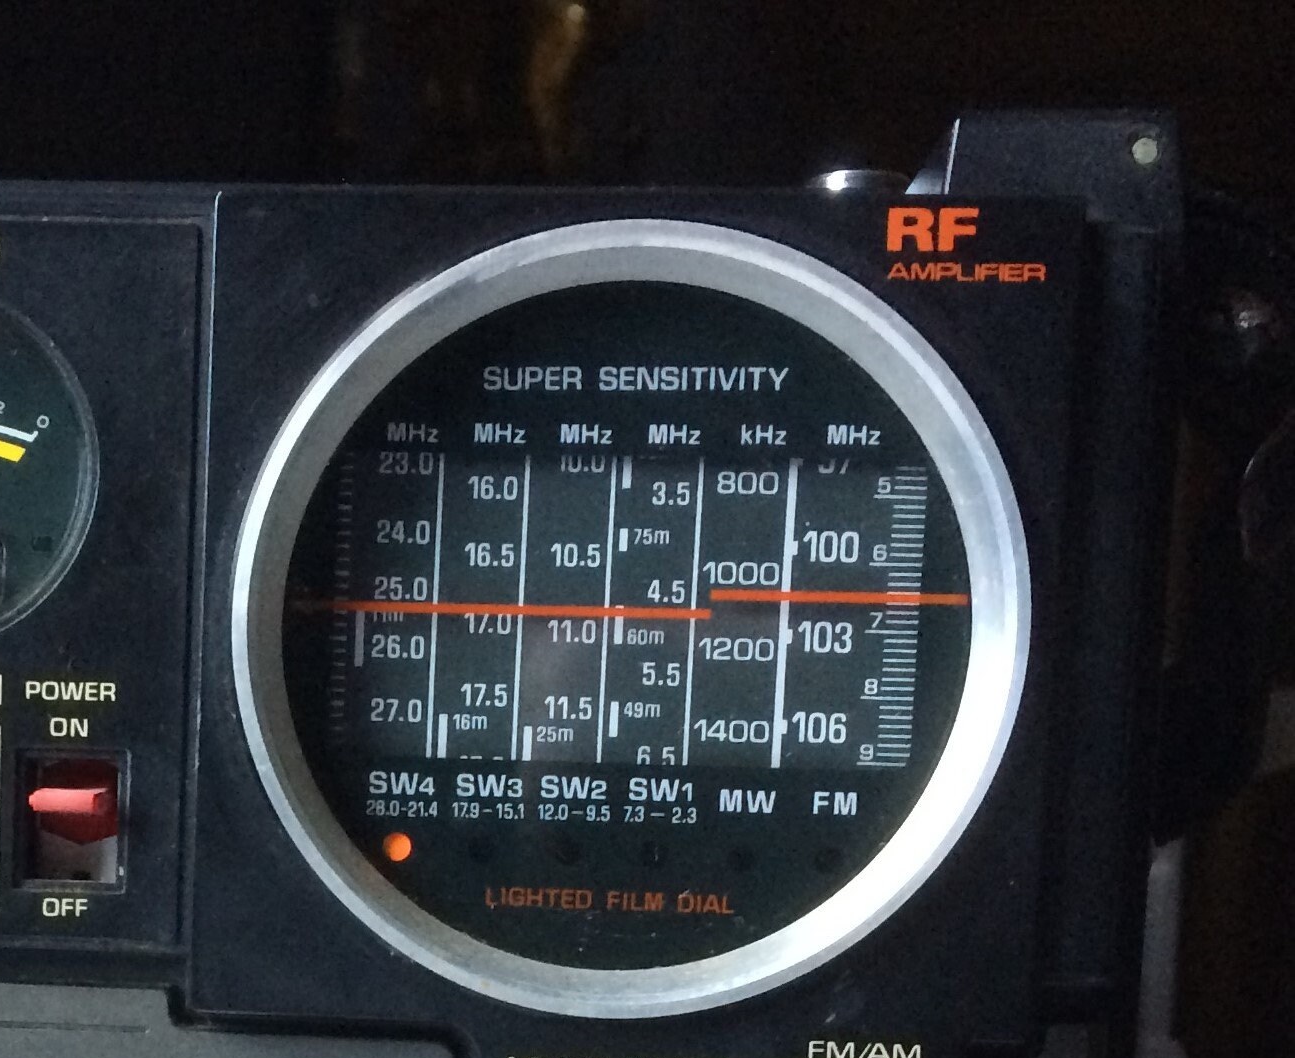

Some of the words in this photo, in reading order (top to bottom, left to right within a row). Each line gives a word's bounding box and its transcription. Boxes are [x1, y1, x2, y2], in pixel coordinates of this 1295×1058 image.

[887, 207, 979, 252] RF
[887, 262, 1047, 282] AMPLIFIER
[483, 366, 582, 391] SUPER
[598, 365, 789, 392] SENSITIVITY
[37, 414, 50, 429] 0
[386, 422, 439, 444] MHz
[474, 423, 527, 444] MHz
[560, 423, 613, 444] MHz
[648, 424, 701, 445] MHz
[740, 424, 787, 445] kHz
[827, 425, 881, 446] MHz
[378, 451, 434, 476] 23.0
[468, 475, 518, 501] 16.0
[652, 481, 690, 506] 3.5
[717, 471, 779, 495] 800
[878, 477, 892, 494] 5
[377, 520, 431, 545] 24.0
[633, 528, 670, 546] 75m
[464, 543, 515, 568] 16.5
[551, 543, 601, 568] 10.5
[803, 530, 860, 563] 100
[873, 544, 888, 561] 6
[703, 561, 780, 585] 1000
[374, 576, 428, 601] 25.0
[647, 579, 685, 604] 4.5
[547, 619, 596, 644] 11.0
[870, 612, 883, 628] 7
[371, 634, 425, 659] 26.0
[627, 628, 665, 645] 60m
[798, 621, 853, 654] 103
[698, 638, 775, 661] 1200
[642, 662, 680, 686] 5.5
[25, 681, 117, 702] POWER
[460, 683, 508, 708] 17.5
[864, 679, 878, 695] 8
[370, 698, 422, 723] 27.0
[544, 696, 592, 720] 11.5
[624, 702, 661, 718] 49m
[50, 718, 89, 738] ON
[453, 713, 488, 731] 16m
[693, 719, 770, 743] 1400
[792, 711, 848, 744] 106
[536, 726, 574, 743] 25m
[859, 744, 874, 760] 9
[368, 771, 435, 796] SW4
[456, 773, 524, 798] SW3
[540, 776, 607, 801] SW2
[629, 777, 693, 802] SW1
[718, 789, 777, 814] MW
[813, 792, 857, 816] FM
[42, 899, 88, 918] OFF
[485, 887, 593, 910] LIGHTED
[607, 891, 663, 912] FILM
[677, 891, 735, 914] DIAL
